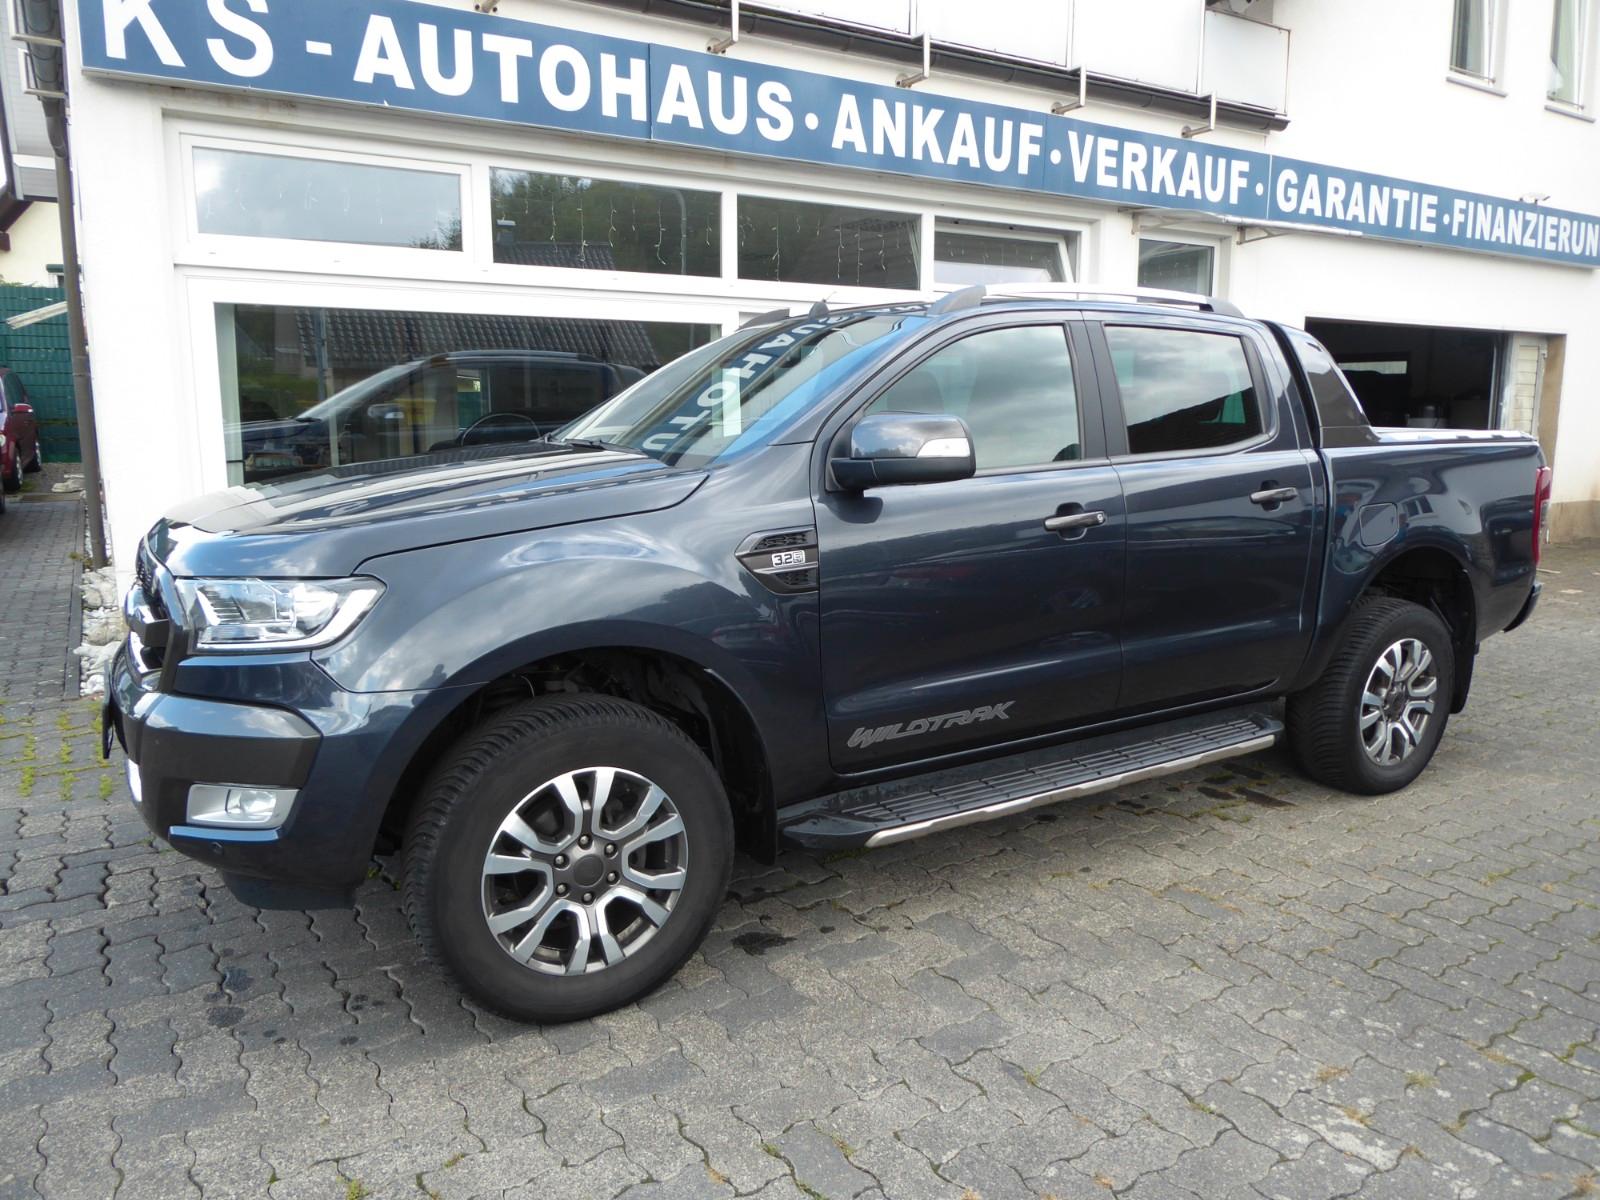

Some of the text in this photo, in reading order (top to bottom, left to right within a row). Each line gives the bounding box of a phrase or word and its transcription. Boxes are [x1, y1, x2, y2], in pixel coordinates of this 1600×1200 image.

[354, 14, 793, 142] AUTOHAUS
[832, 93, 1044, 175] ANKAUF
[1068, 130, 1249, 205] VERKAUF
[1276, 168, 1439, 233] GARANTIE
[847, 700, 1016, 749] WILDTRAK
